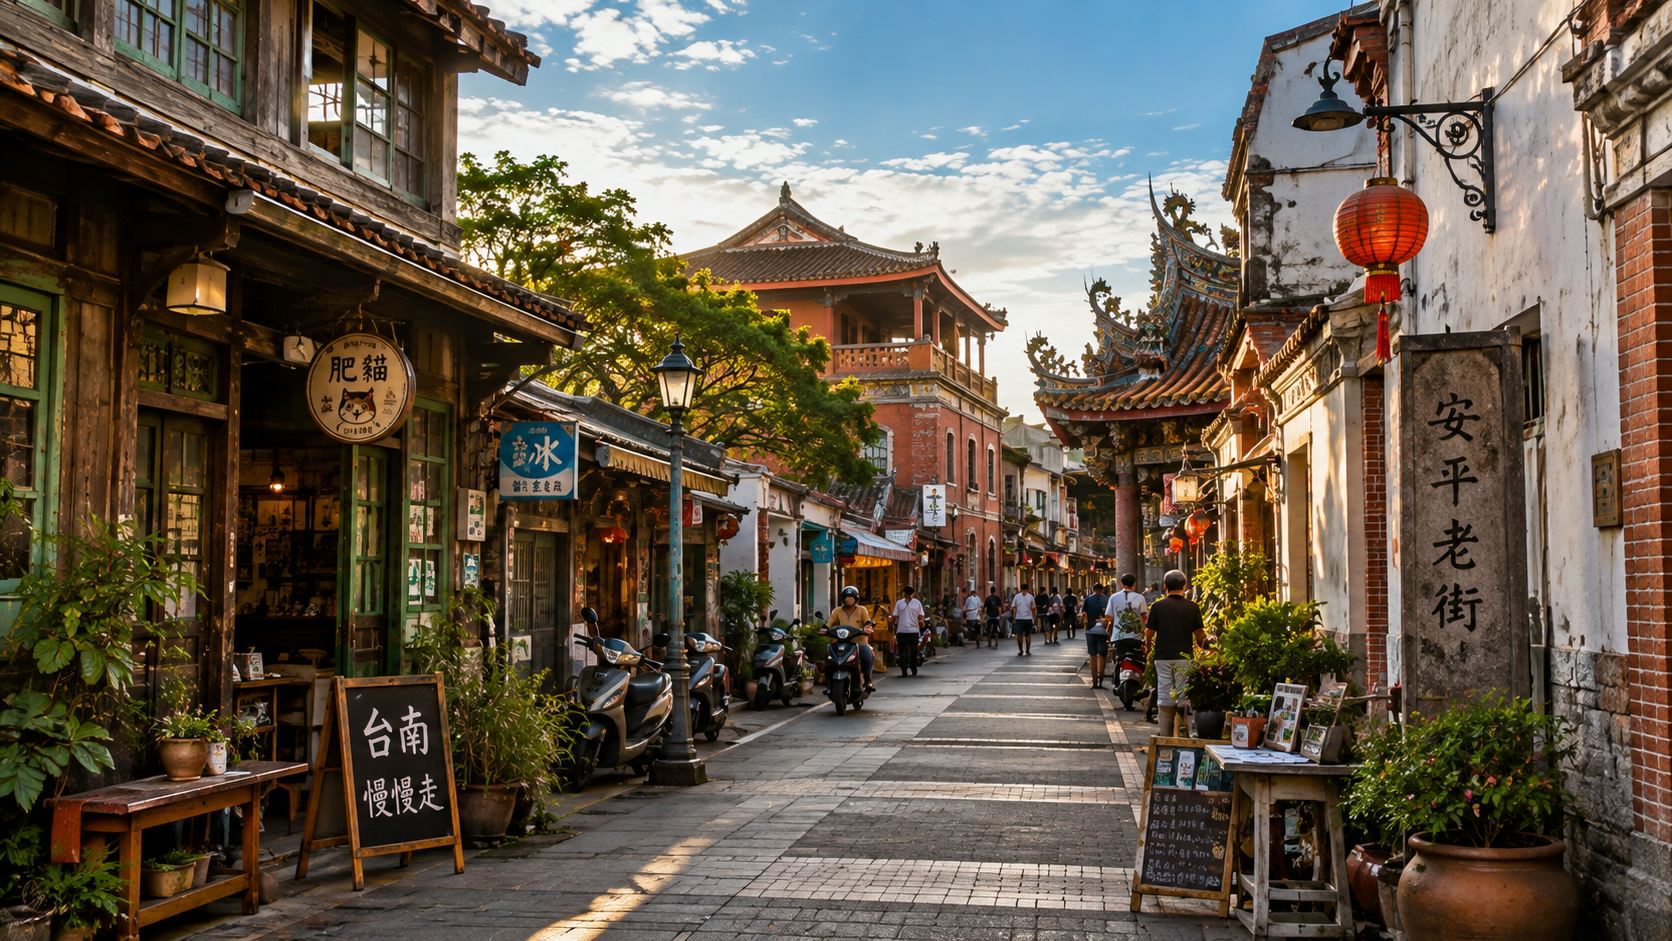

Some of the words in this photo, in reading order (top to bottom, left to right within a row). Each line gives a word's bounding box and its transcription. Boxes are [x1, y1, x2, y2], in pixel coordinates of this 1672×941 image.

[328, 353, 388, 383] 肥貓
[1427, 392, 1484, 633] 安平老街
[363, 705, 429, 759] 台南
[363, 773, 445, 819] 慢慢走
